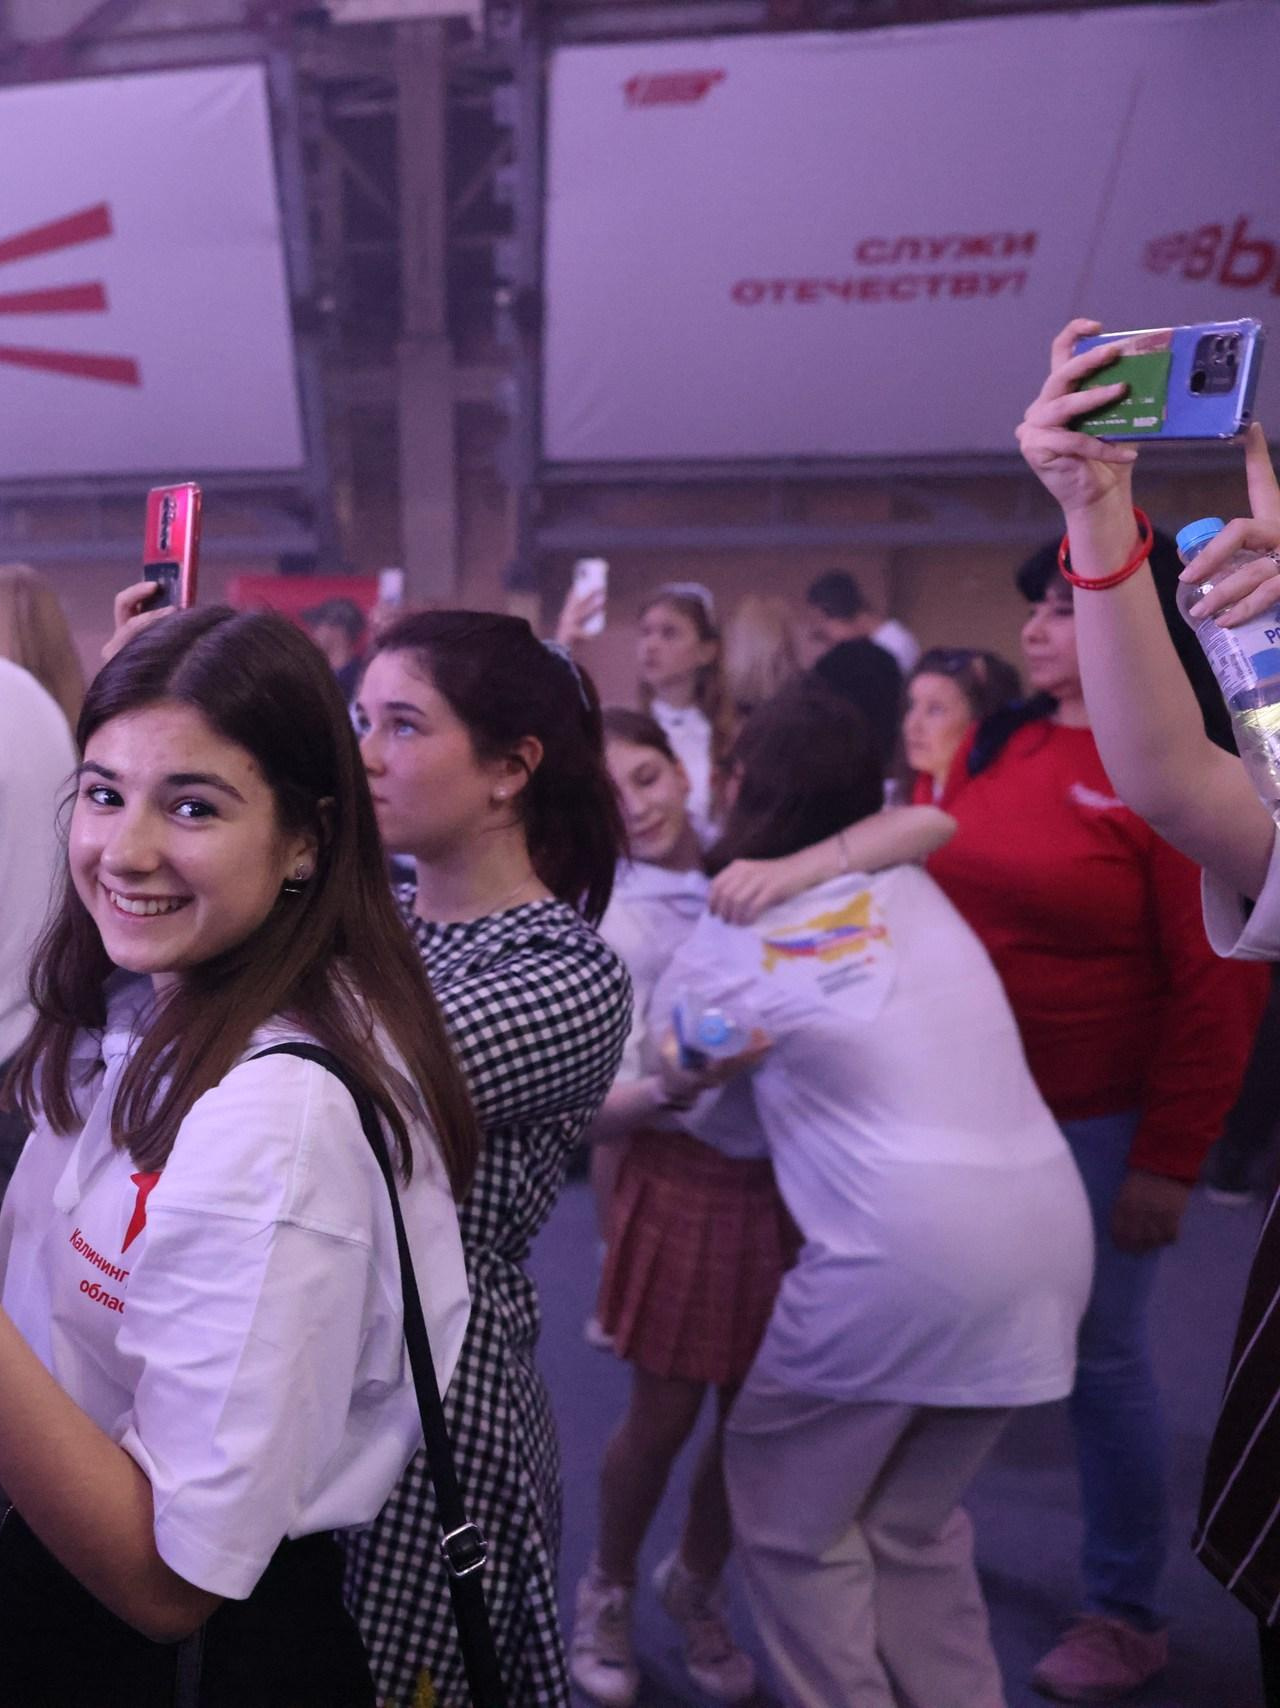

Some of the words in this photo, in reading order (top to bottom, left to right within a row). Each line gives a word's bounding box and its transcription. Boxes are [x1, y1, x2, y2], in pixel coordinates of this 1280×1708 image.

[855, 230, 1038, 265] СЛУЖИ
[730, 269, 1028, 306] ОТЕЧЕСТВУ!
[70, 1229, 129, 1282] Калининг
[79, 1279, 125, 1313] облас
